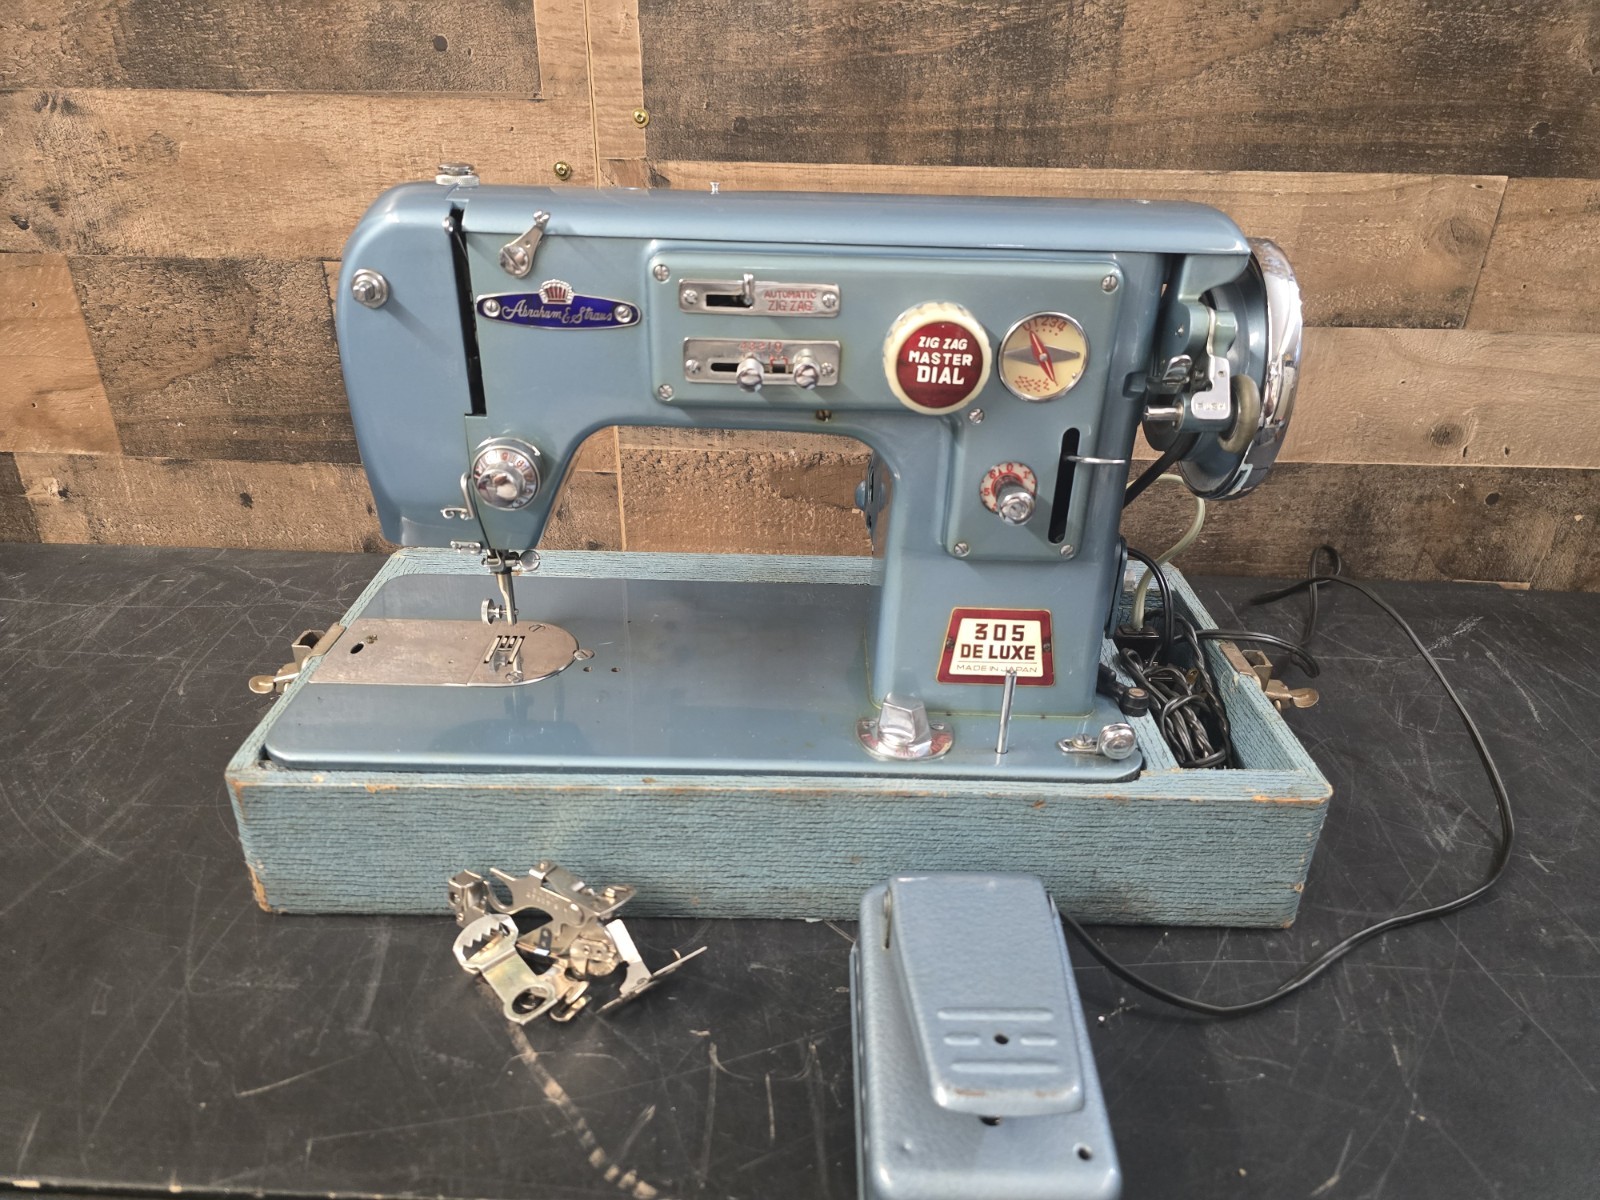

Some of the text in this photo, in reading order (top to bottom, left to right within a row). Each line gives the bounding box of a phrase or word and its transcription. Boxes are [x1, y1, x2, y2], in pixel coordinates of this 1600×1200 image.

[764, 288, 817, 299] AUTOMATIC
[502, 300, 561, 319] Abraham
[571, 306, 613, 324] Straus
[768, 300, 813, 312] ZIG ZAG
[918, 336, 968, 350] ZIG ZAG
[908, 350, 973, 366] MASTER
[917, 365, 965, 385] DIAL
[974, 623, 1025, 642] 305
[960, 644, 1036, 661] DE LUXE
[956, 664, 987, 672] MADE
